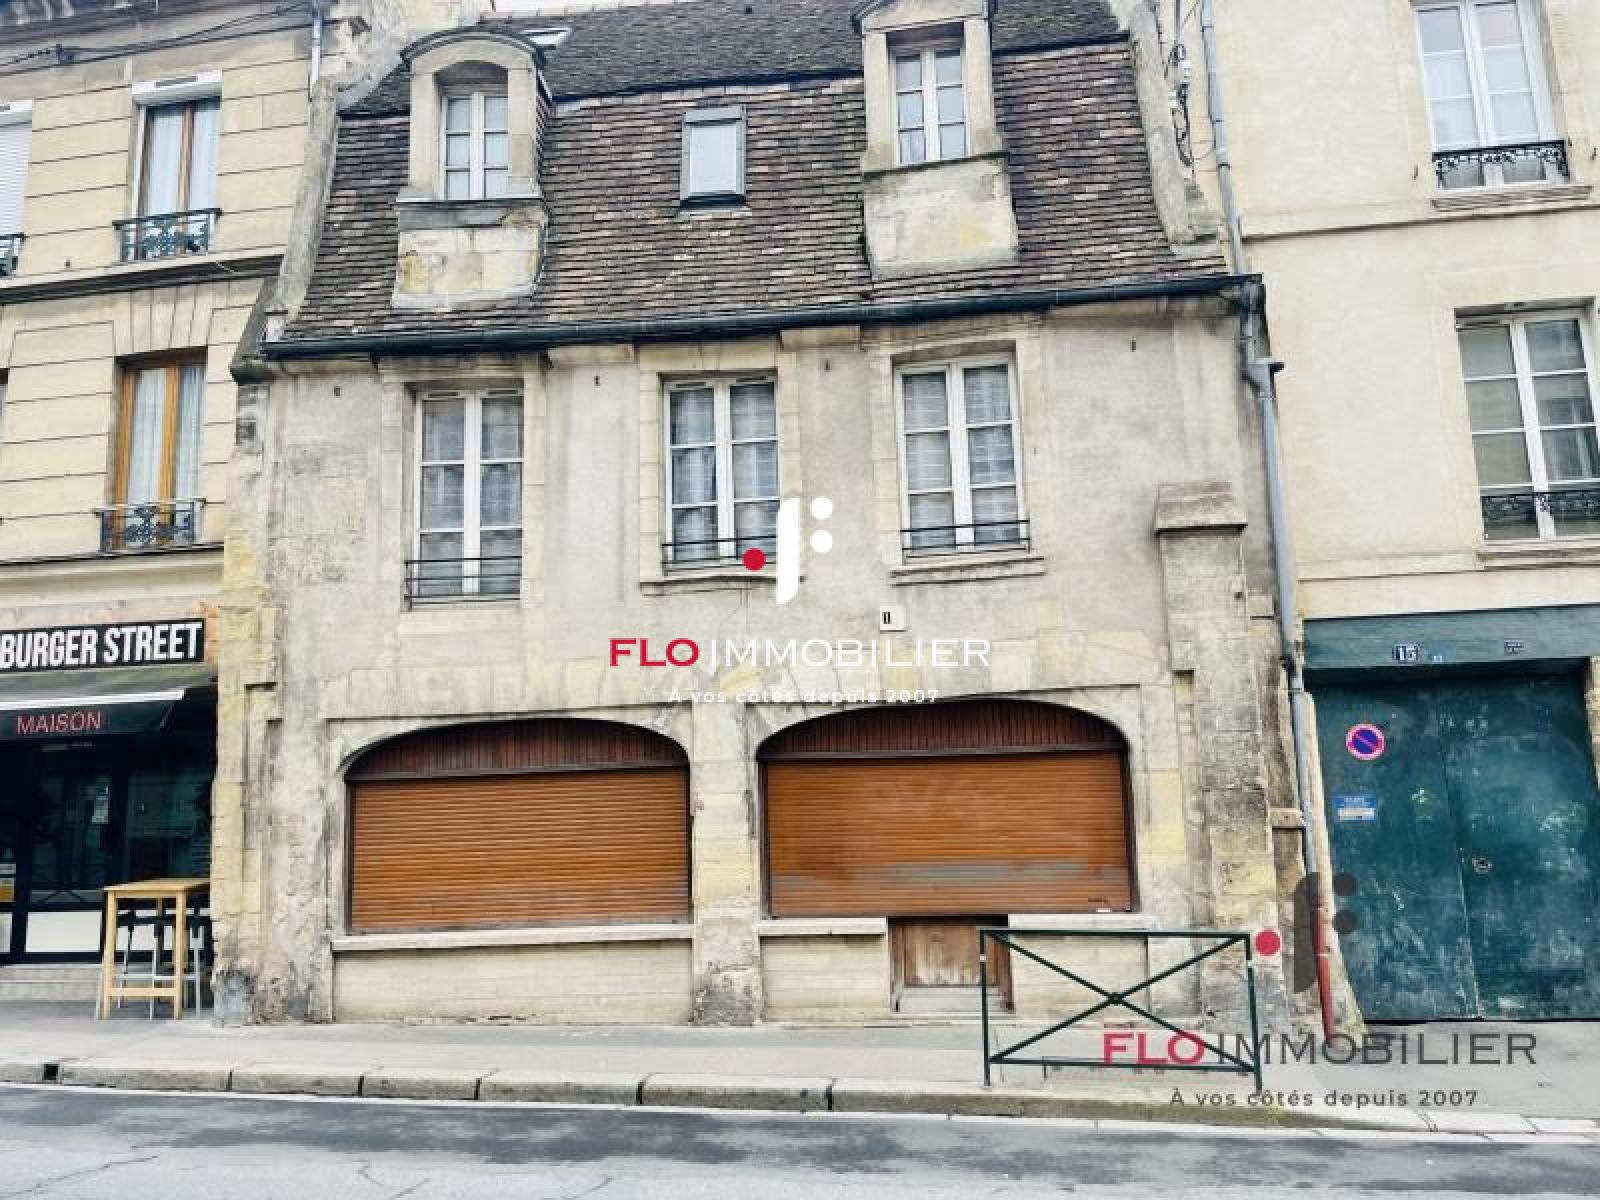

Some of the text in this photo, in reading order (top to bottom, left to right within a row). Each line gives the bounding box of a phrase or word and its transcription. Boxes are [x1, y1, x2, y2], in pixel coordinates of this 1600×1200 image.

[0, 621, 203, 669] BURGER STREET
[16, 711, 101, 735] MAISON
